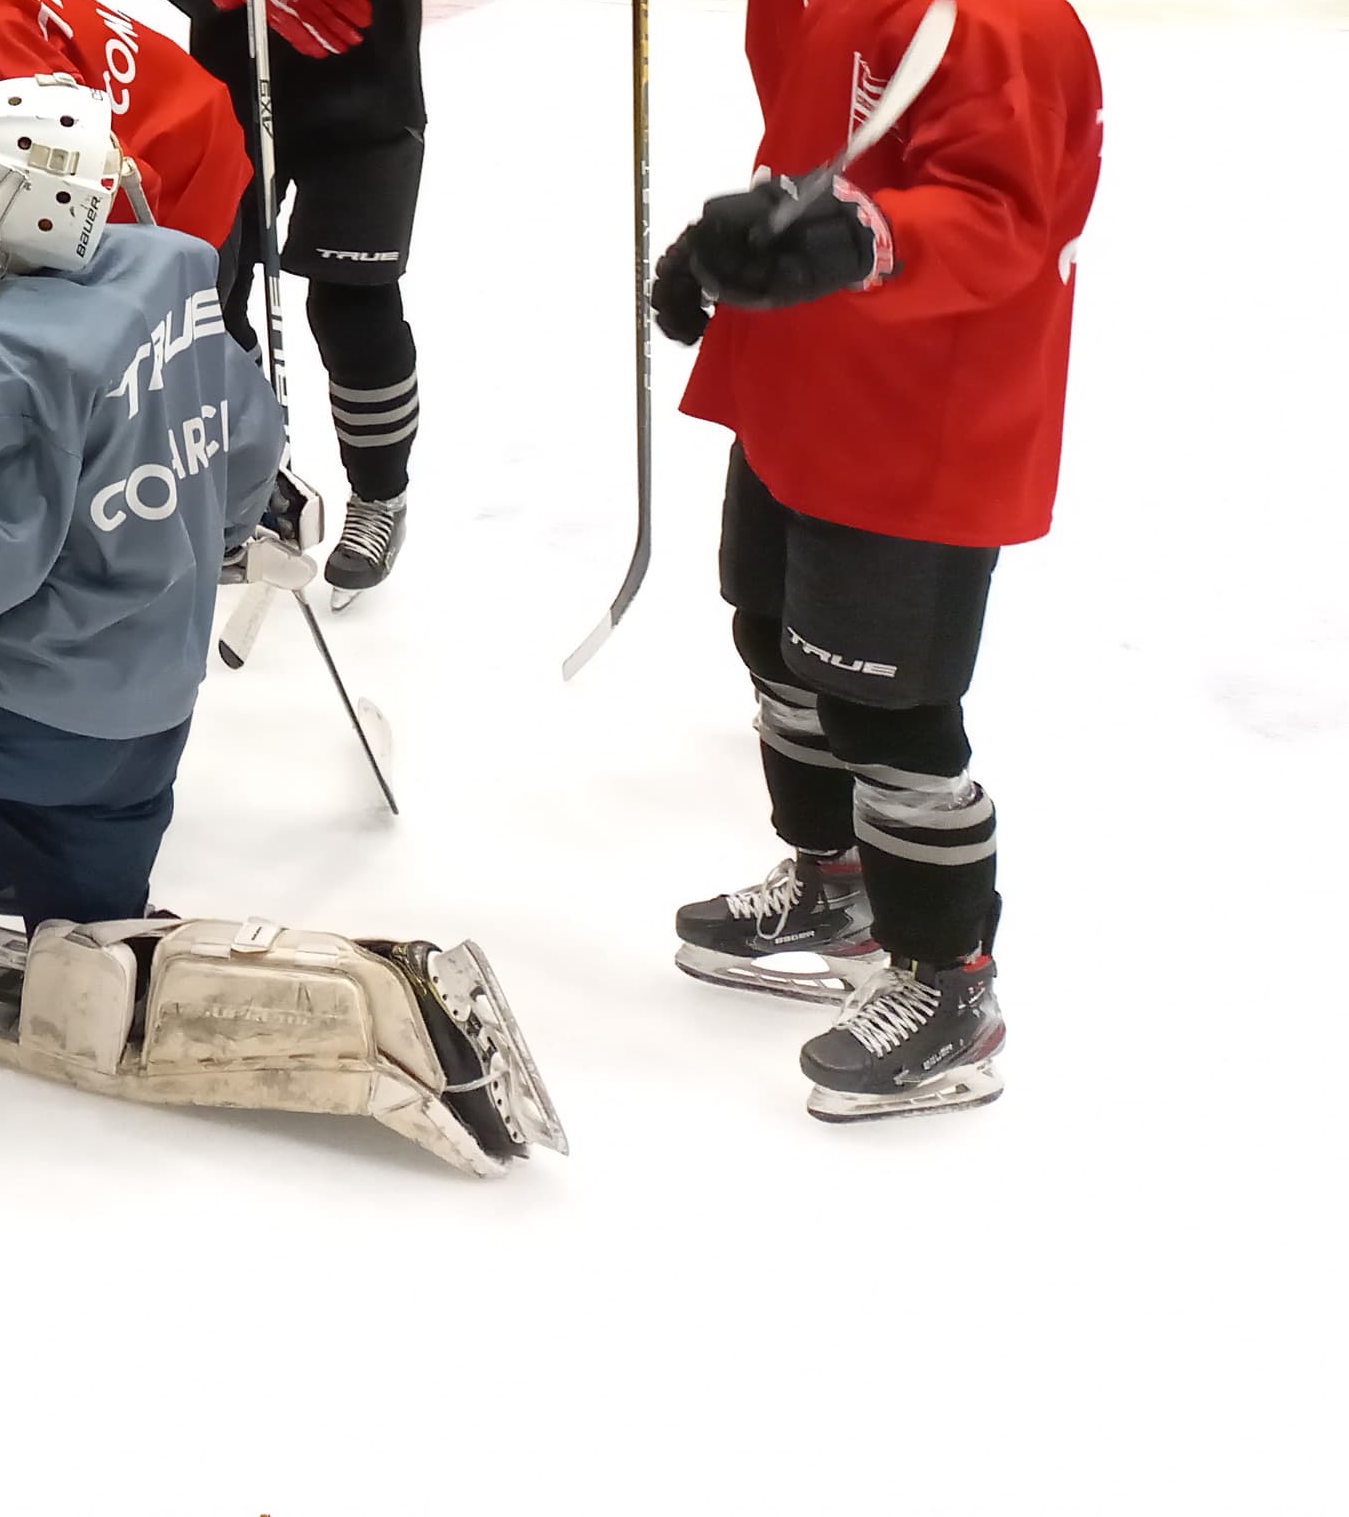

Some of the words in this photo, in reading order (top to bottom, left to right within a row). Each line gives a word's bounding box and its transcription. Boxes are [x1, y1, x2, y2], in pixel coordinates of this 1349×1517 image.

[314, 247, 401, 263] TRUE
[106, 287, 227, 421] TRUE
[786, 626, 898, 678] TRUE
